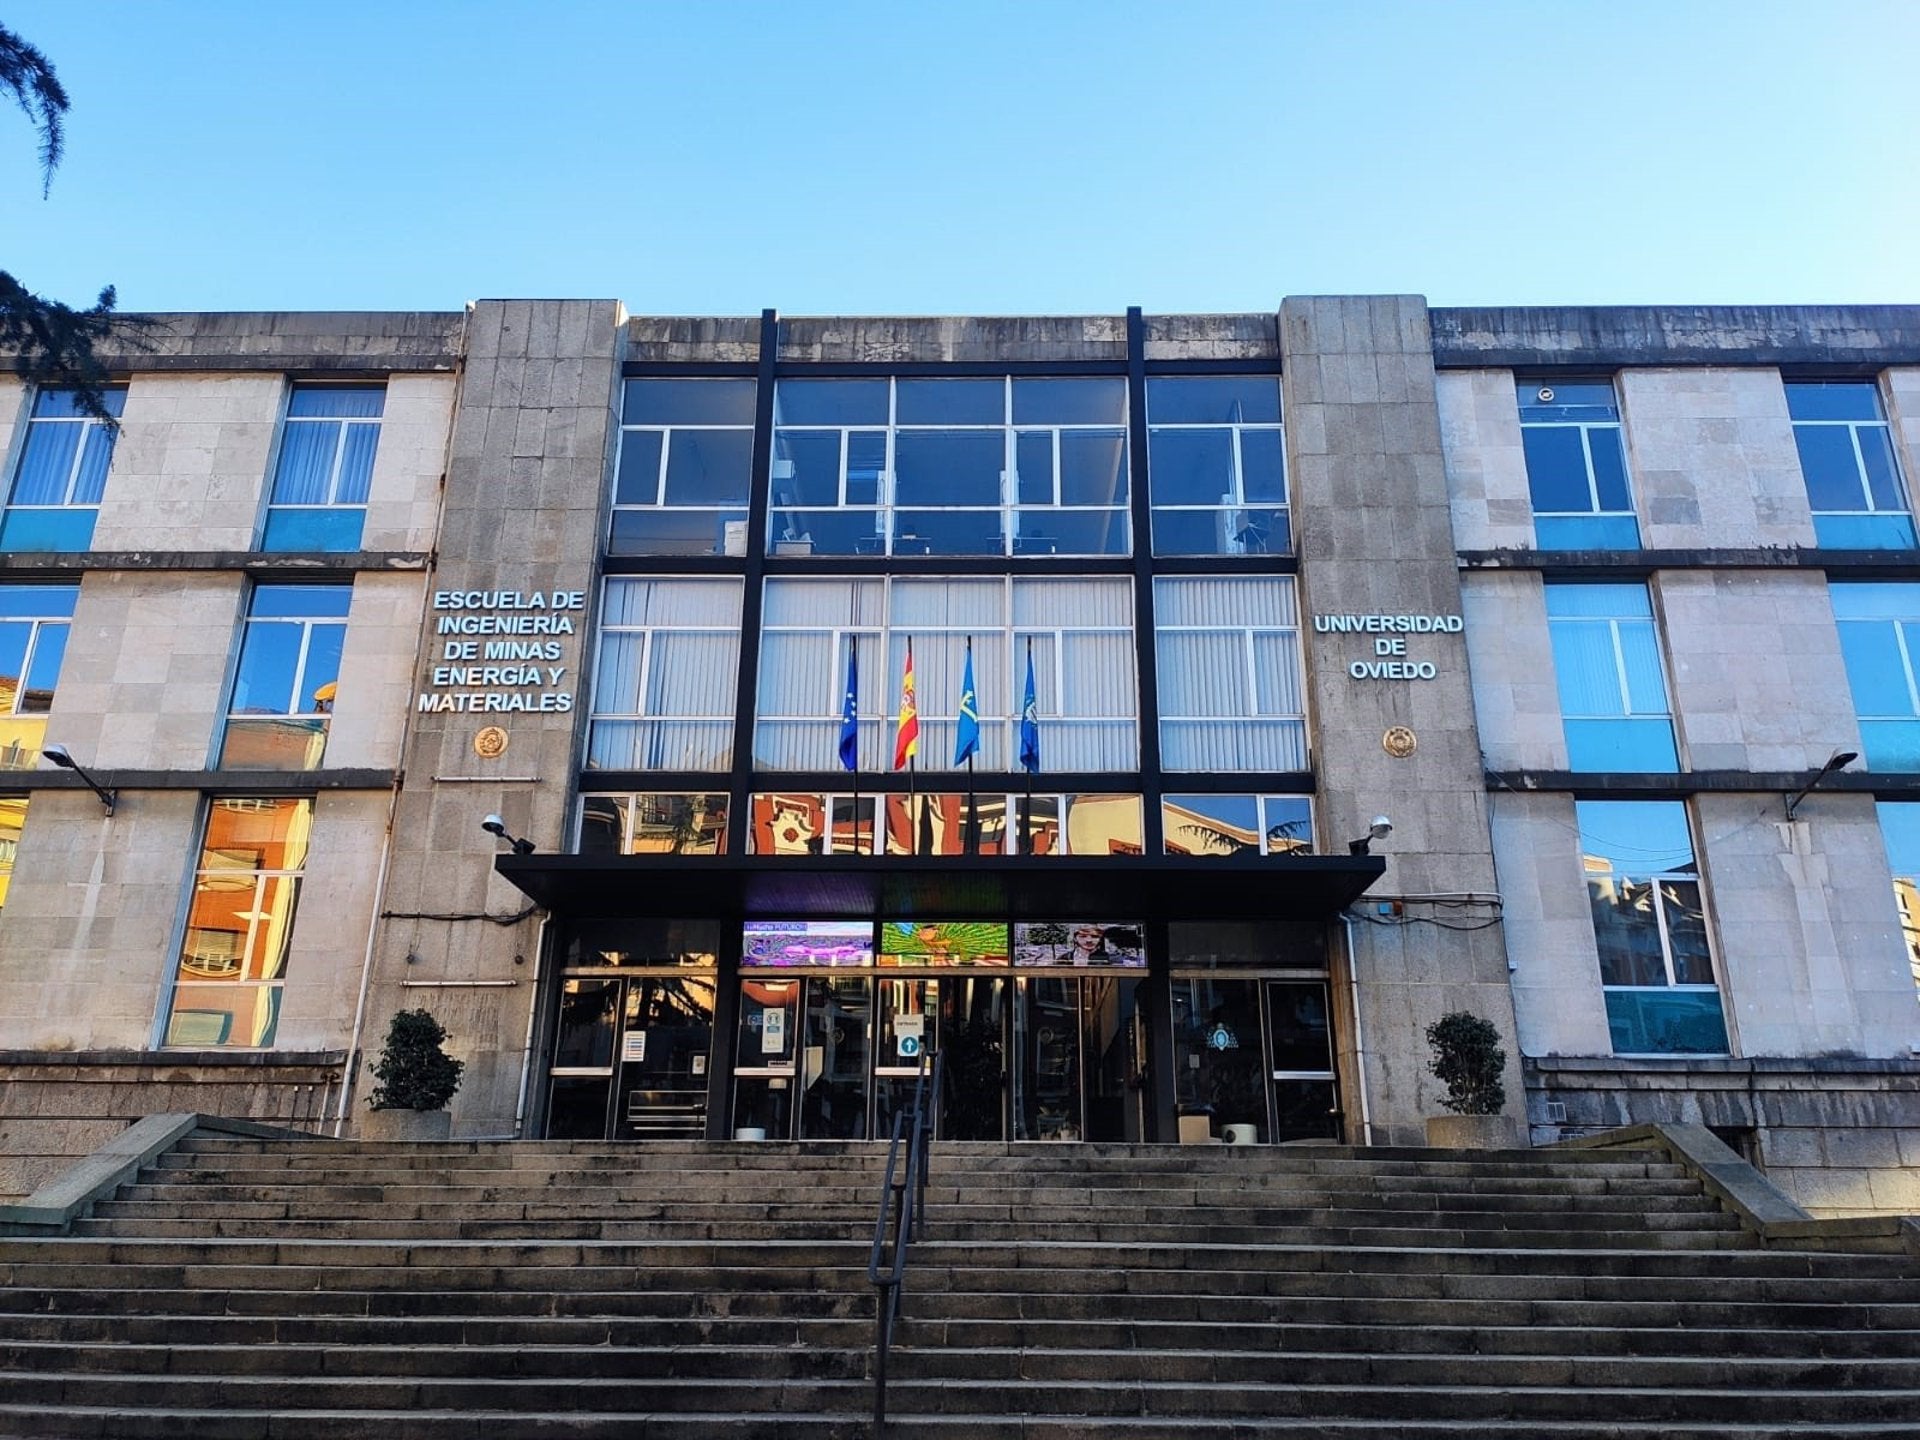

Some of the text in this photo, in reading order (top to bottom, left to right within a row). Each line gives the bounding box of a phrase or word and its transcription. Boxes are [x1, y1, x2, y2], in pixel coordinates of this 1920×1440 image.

[433, 591, 584, 610] ESCUELA DE
[437, 612, 575, 635] INGENIERÍA
[1314, 615, 1464, 633] UNIVERSIDAD
[444, 641, 561, 660] DE MINAS
[1375, 638, 1407, 656] DE
[433, 663, 566, 686] ENERGÍA Y
[1350, 661, 1436, 679] OVIEDO
[418, 693, 572, 712] MATERIALES
